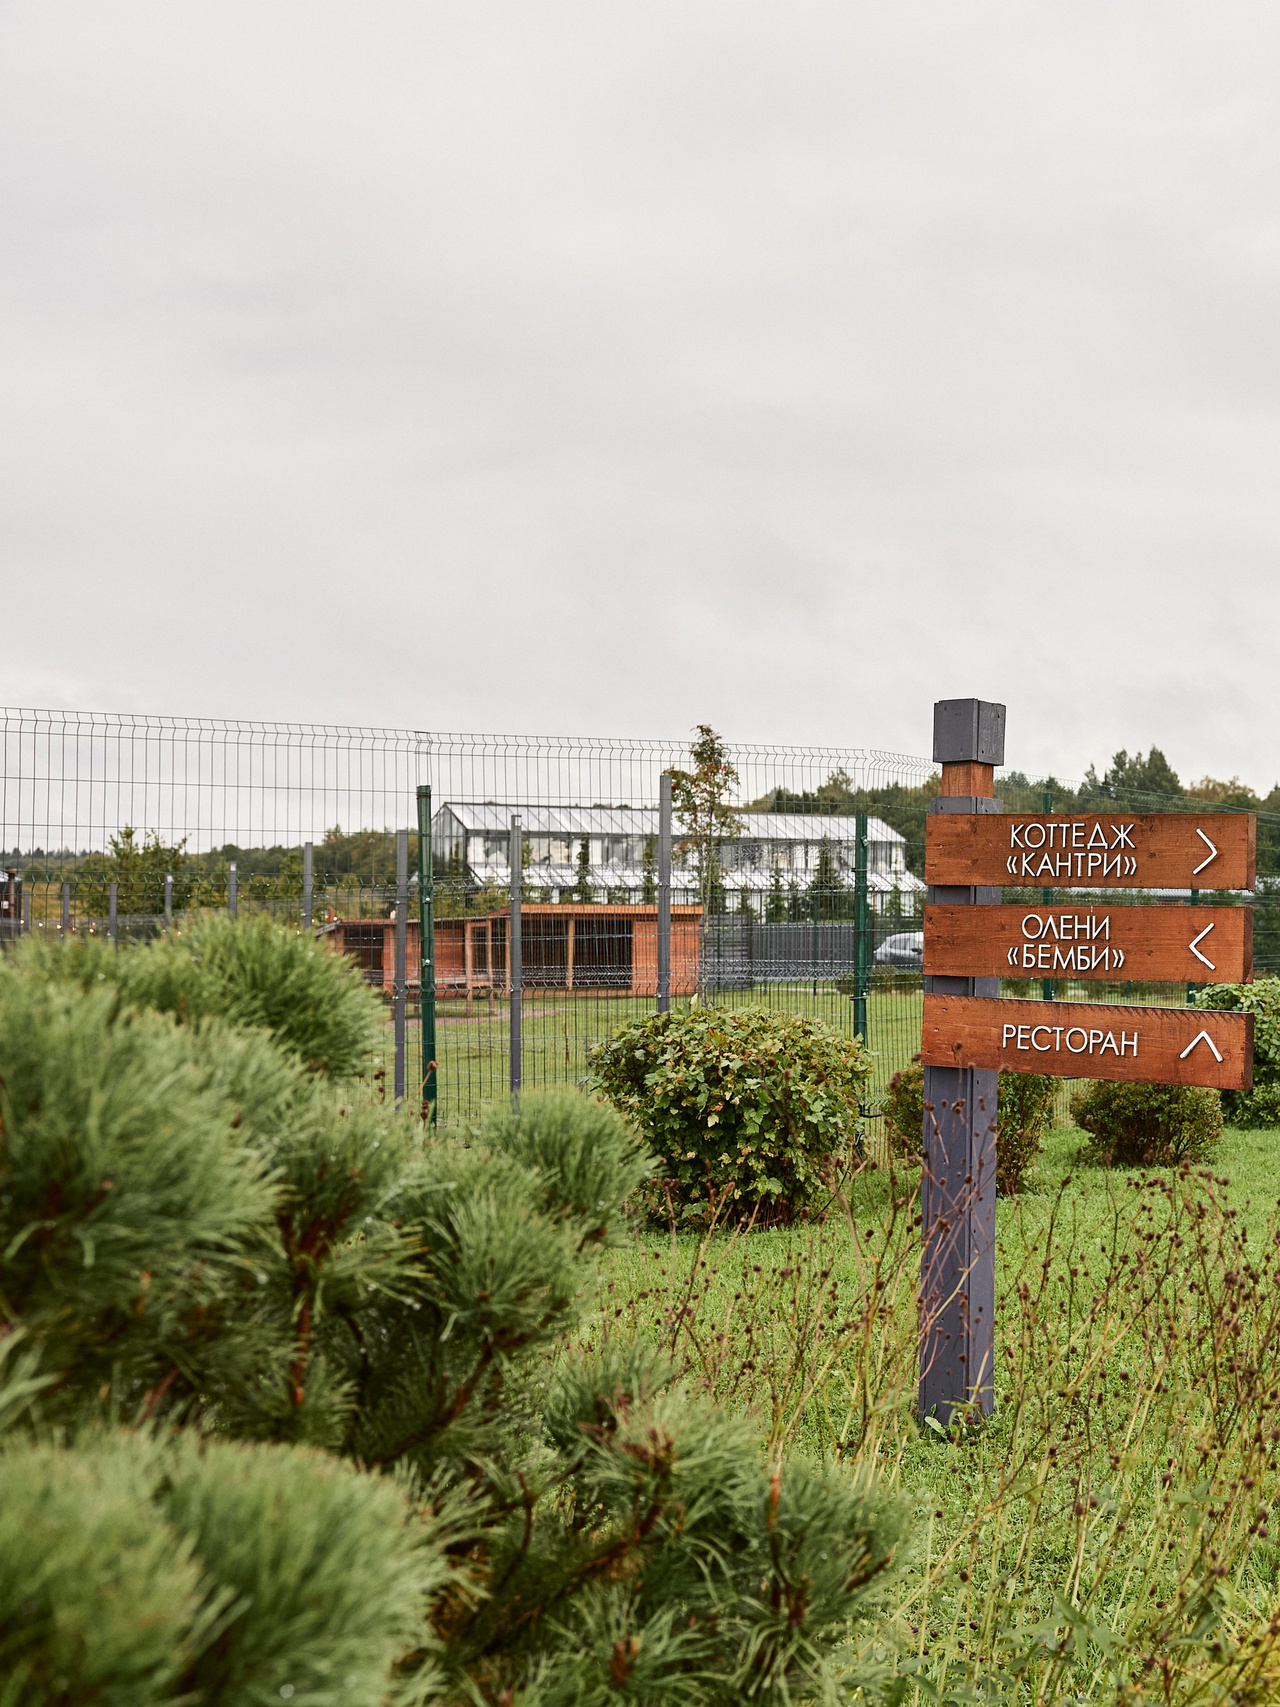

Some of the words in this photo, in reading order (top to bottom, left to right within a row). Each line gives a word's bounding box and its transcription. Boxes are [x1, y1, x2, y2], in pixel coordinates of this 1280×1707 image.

[1010, 822, 1136, 849] КОТТЕДЖ
[1006, 852, 1137, 878] «КАНТРИ»
[1021, 914, 1110, 940] ОЛЕНИ
[1007, 944, 1125, 971] «БЕМБИ»
[1002, 1024, 1139, 1057] РЕСТОРАН
